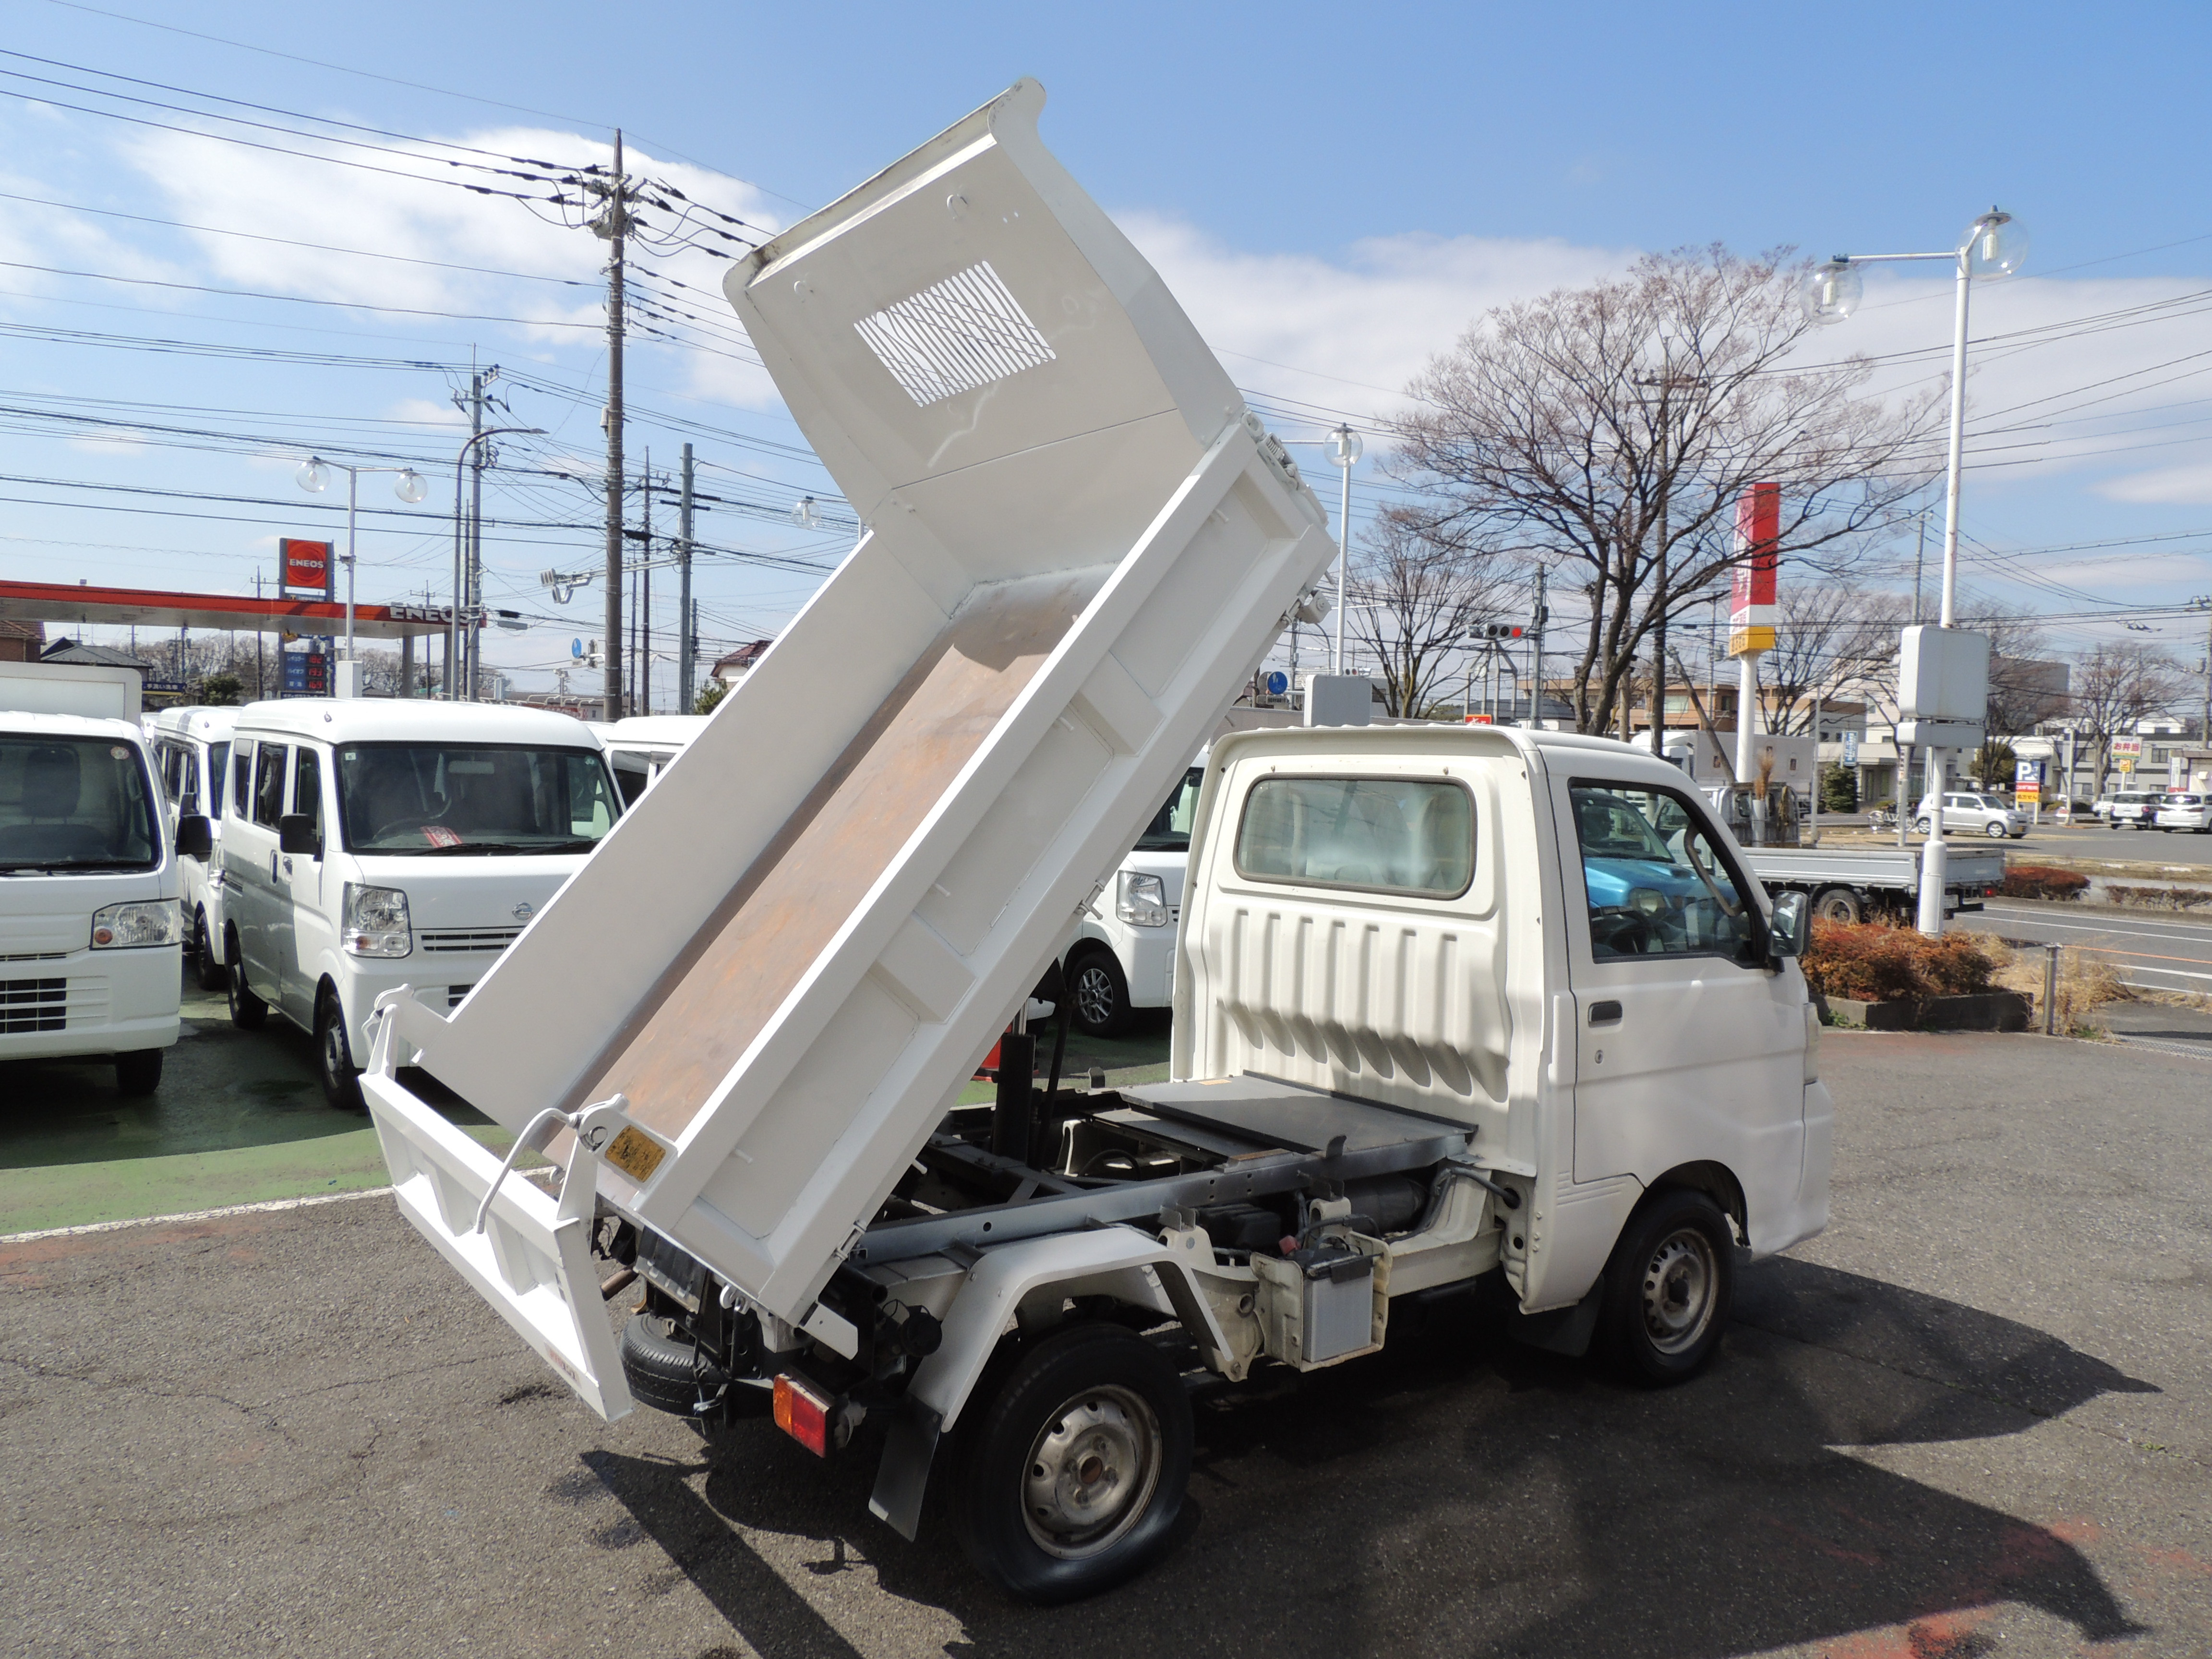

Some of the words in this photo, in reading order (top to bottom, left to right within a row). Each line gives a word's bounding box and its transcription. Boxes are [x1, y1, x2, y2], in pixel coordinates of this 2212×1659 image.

[289, 558, 324, 569] ENEOS
[390, 602, 472, 624] ENEOS
[2114, 742, 2140, 751] お弁当
[2018, 762, 2032, 781] P
